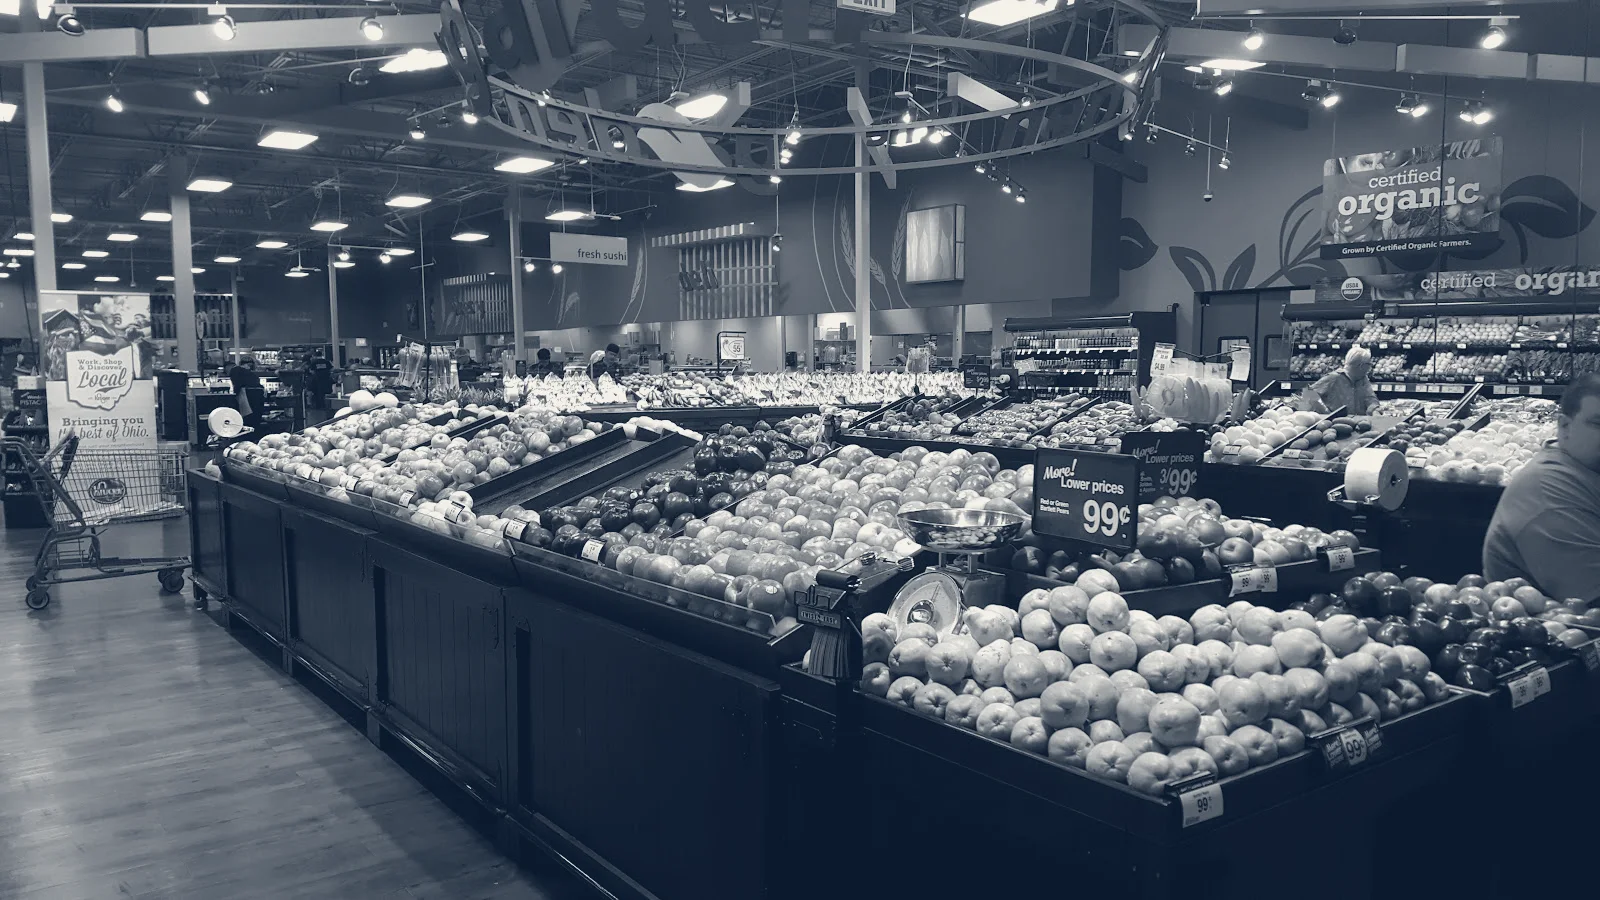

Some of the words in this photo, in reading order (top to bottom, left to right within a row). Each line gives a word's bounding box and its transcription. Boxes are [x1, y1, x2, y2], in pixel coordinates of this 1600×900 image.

[1368, 166, 1442, 189] certified
[1338, 176, 1480, 221] organic
[577, 248, 601, 260] fresh
[603, 251, 627, 262] sushi
[1342, 246, 1365, 255] Grown
[1366, 245, 1375, 255] by
[1376, 242, 1407, 252] Certified
[1408, 240, 1438, 252] Organic
[1439, 239, 1472, 248] Farmers.
[1420, 272, 1497, 291] certified
[77, 358, 101, 366] Work,
[103, 358, 123, 367] Shop
[77, 367, 127, 389] Local
[62, 416, 119, 430] Bringing
[122, 417, 144, 429] you
[80, 426, 103, 440] best
[106, 425, 119, 442] of
[122, 424, 149, 439] Ohio.
[1131, 439, 1161, 458] More!
[1145, 453, 1170, 465] Lower
[1170, 452, 1195, 466] prices
[1043, 458, 1078, 480] More!
[1061, 475, 1090, 491] Lower
[1092, 480, 1125, 495] prices
[1040, 498, 1050, 506] Red
[1055, 500, 1070, 508] Green
[1040, 504, 1056, 513] Bartlett
[1056, 507, 1070, 515] Pears
[1083, 499, 1131, 537] 99¢
